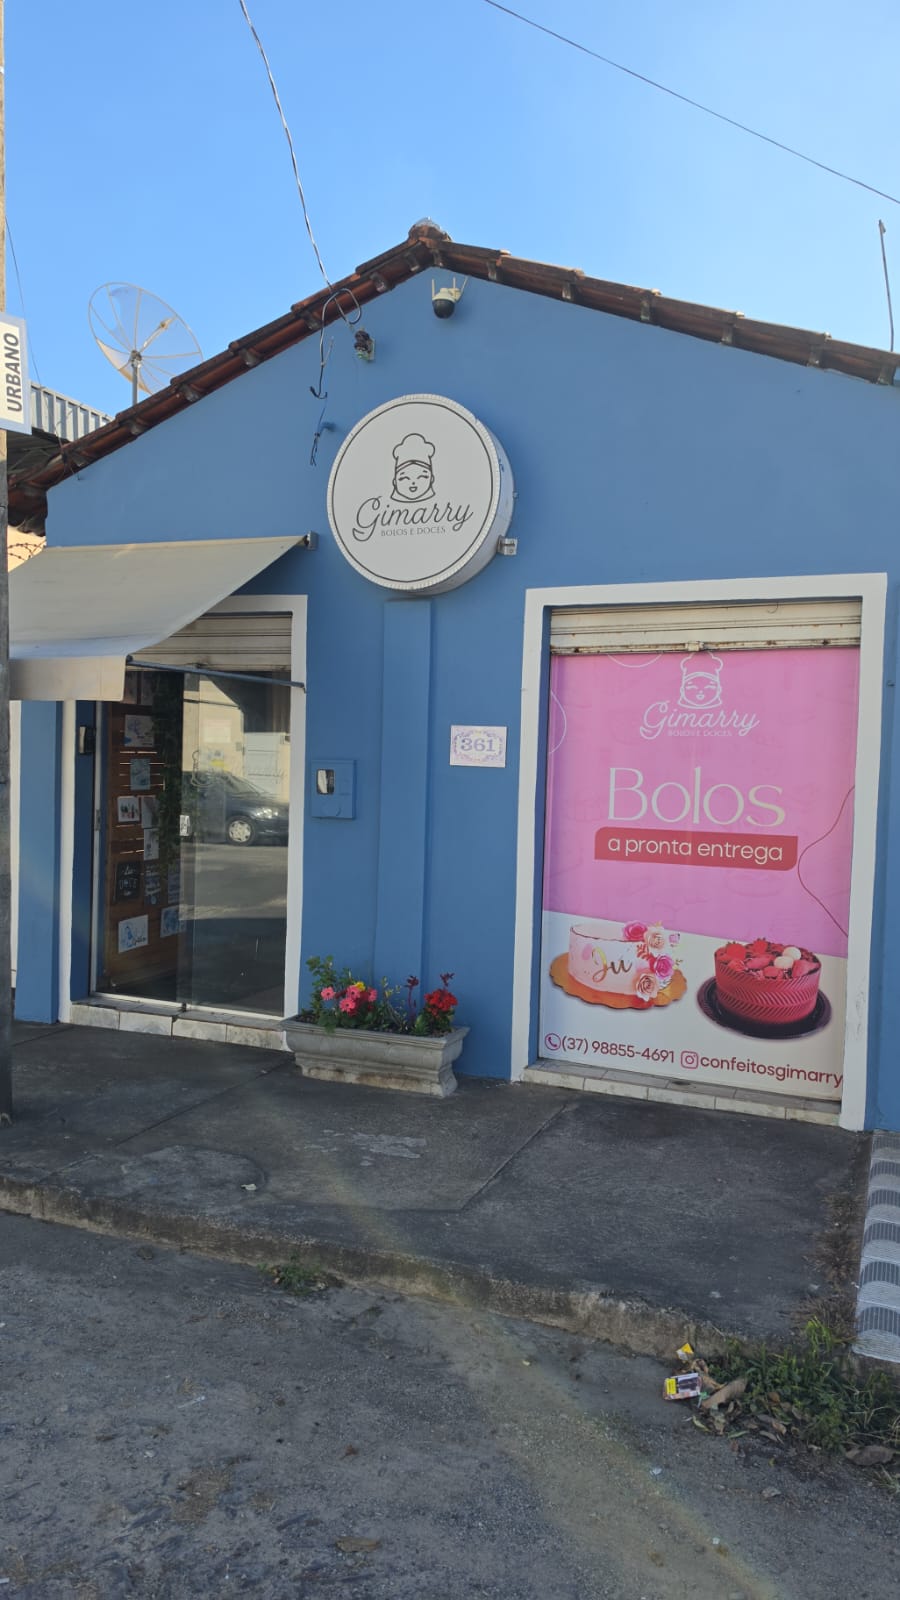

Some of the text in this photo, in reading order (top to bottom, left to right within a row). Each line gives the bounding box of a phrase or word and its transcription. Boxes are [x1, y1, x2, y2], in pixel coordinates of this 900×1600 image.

[4, 332, 22, 413] URBANO
[352, 496, 474, 542] Gimarry
[381, 528, 408, 537] BOLOS
[416, 526, 446, 535] DOCES
[640, 700, 760, 740] Gimarry
[461, 738, 496, 752] 361
[608, 766, 786, 827] Bolos
[608, 838, 783, 865] a pronta entrega
[562, 1035, 843, 1088] (37) 98855-4691 confeitosgimarry
